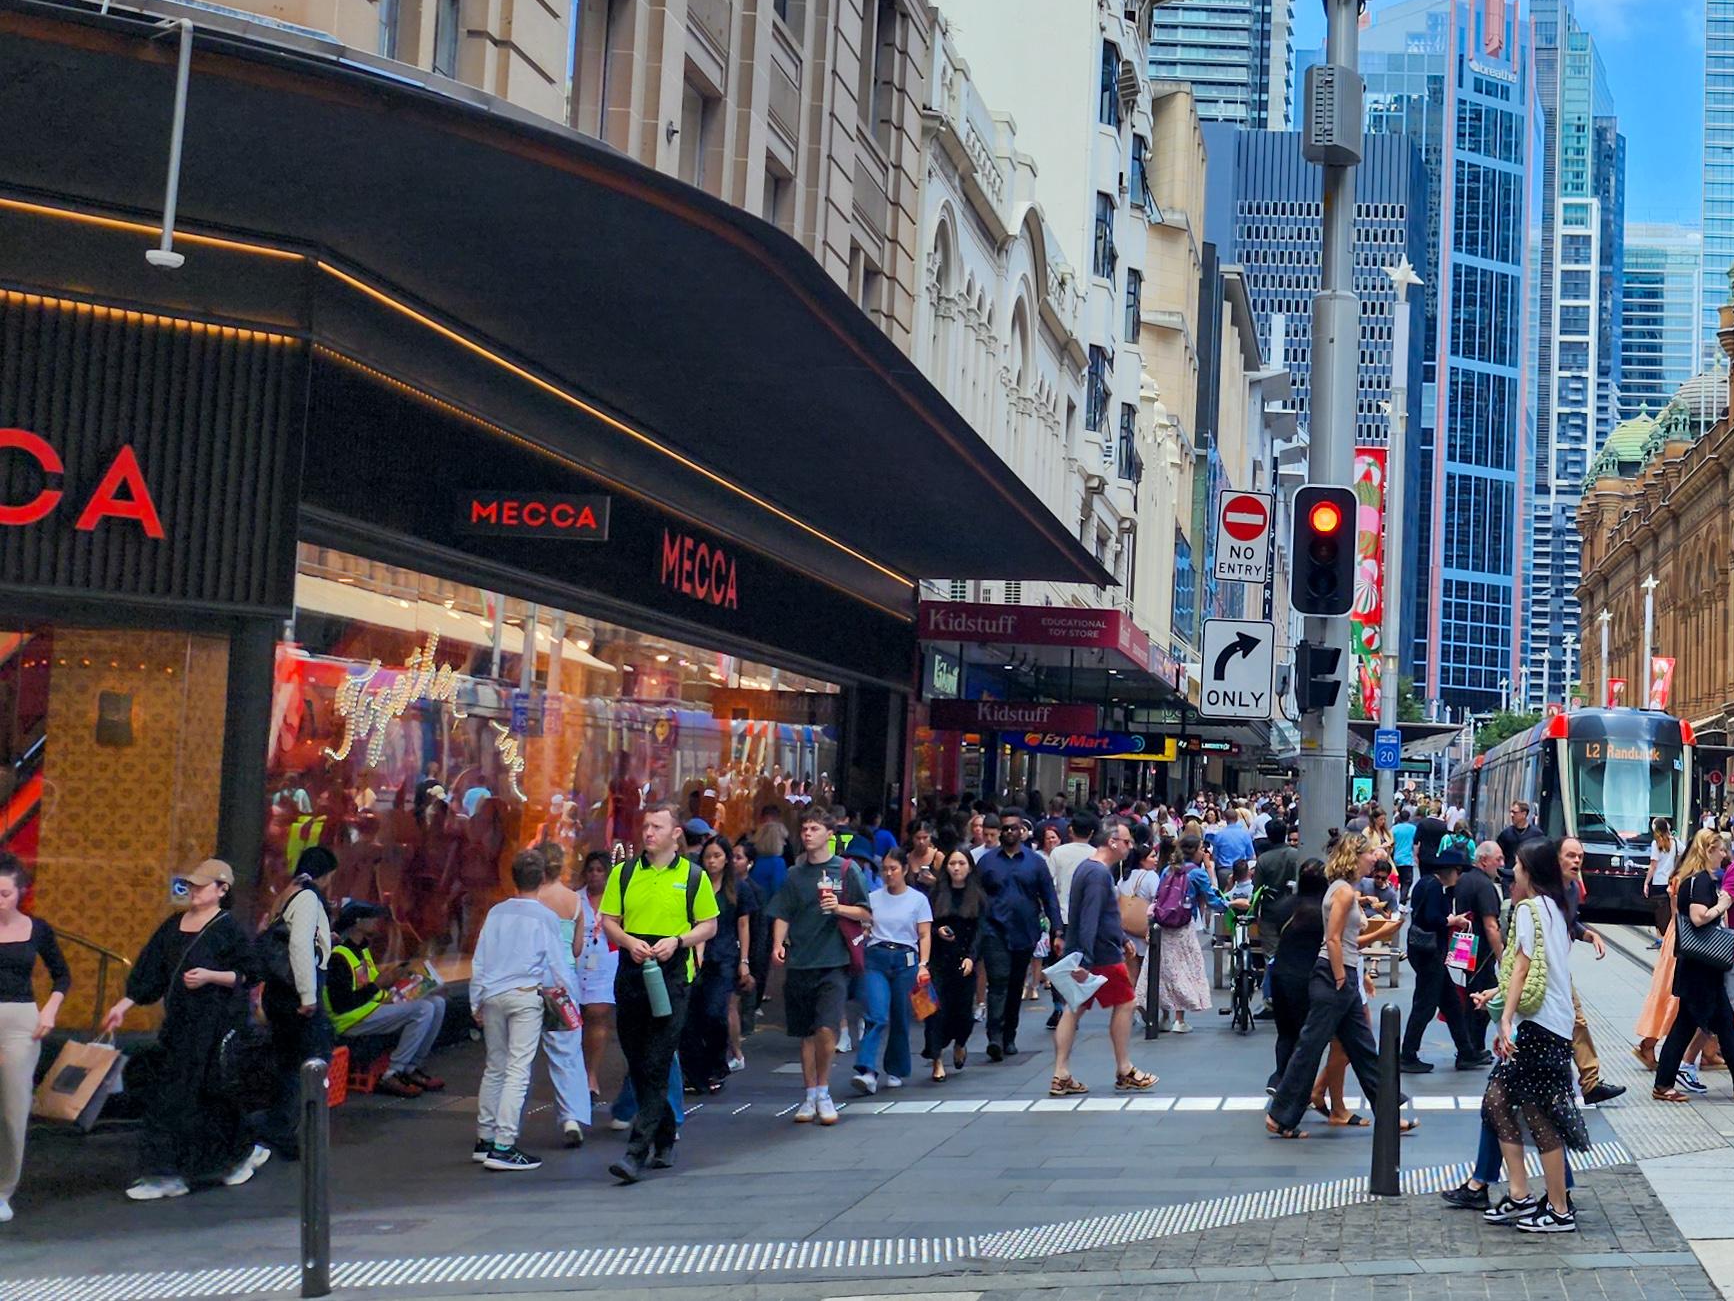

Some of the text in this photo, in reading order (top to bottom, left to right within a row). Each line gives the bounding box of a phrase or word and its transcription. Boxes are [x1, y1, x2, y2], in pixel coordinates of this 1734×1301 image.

[471, 500, 597, 529] MECCA
[1229, 545, 1255, 560] NO
[661, 527, 738, 610] MECCA
[1218, 563, 1263, 576] ENTRY
[929, 608, 1017, 634] Kidstuff
[1041, 618, 1107, 629] EDUCATIONAL
[1048, 628, 1100, 638] TOY STORE
[1206, 689, 1265, 708] ONLY
[977, 702, 1052, 723] Kidstuff
[1042, 733, 1109, 750] EzyMart
[1380, 751, 1394, 762] 20
[1586, 742, 1601, 759] L2
